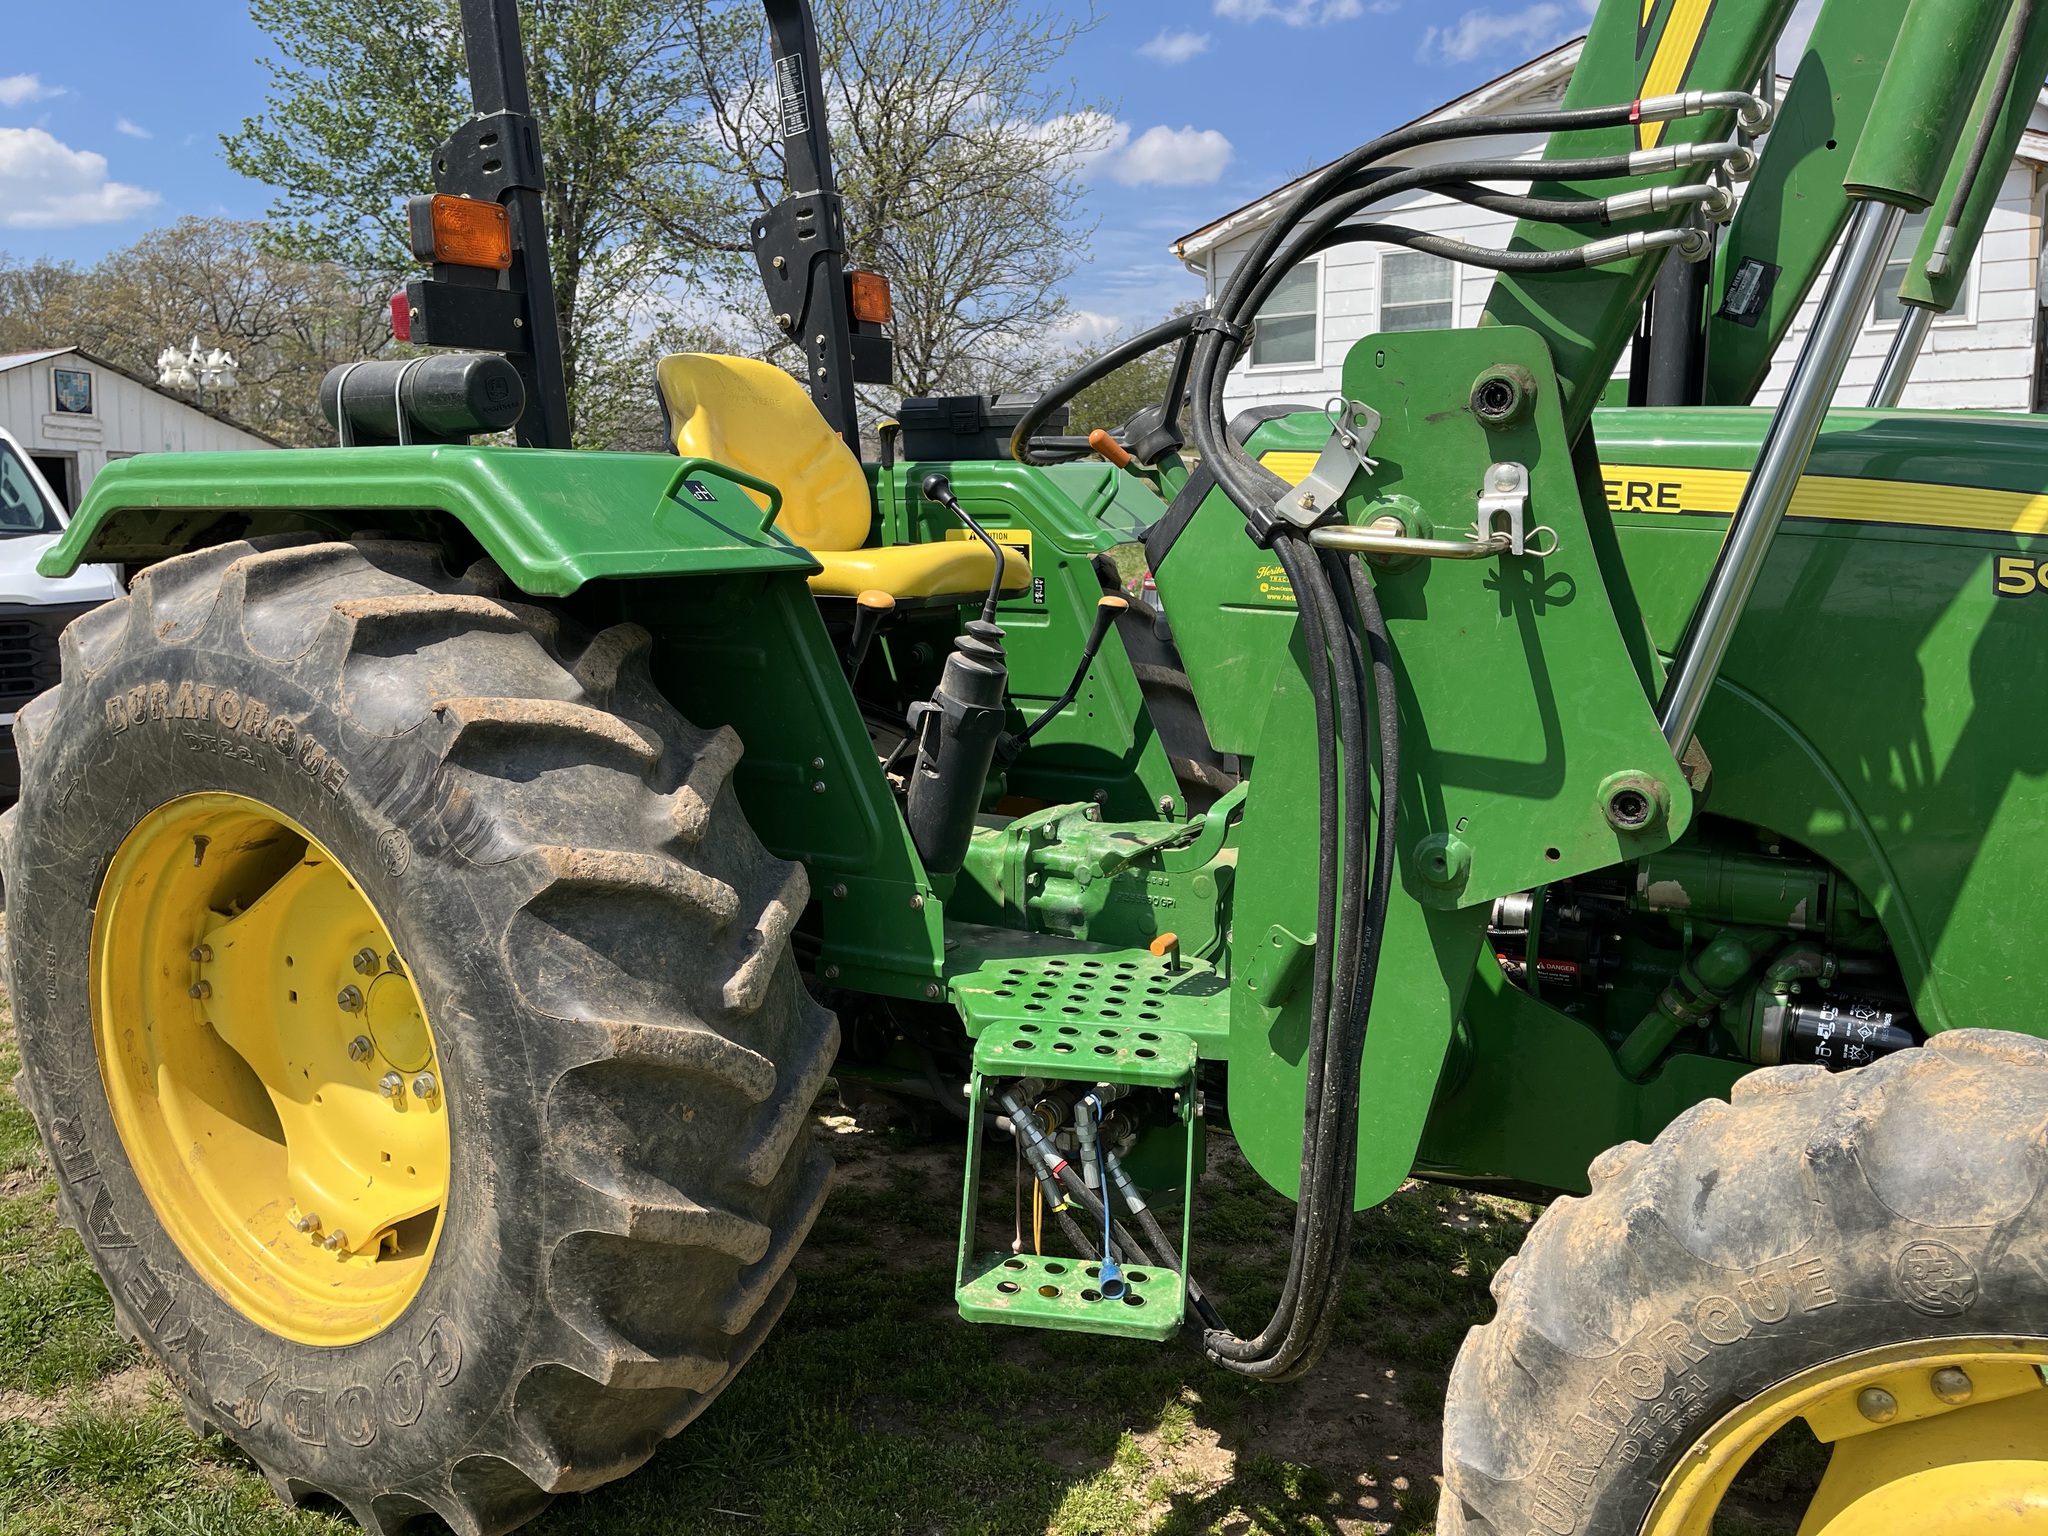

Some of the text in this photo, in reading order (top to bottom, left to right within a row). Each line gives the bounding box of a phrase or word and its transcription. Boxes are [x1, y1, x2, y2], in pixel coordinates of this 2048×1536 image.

[105, 679, 350, 800] DURATORQUE
[182, 731, 268, 773] DT221
[1546, 963, 1576, 972] DANGER
[51, 1112, 463, 1448] GOODYEAR
[1526, 1257, 1837, 1536] URATORQUE
[1617, 1373, 1710, 1464] DT221
[1671, 1402, 1707, 1435] NOTCH
